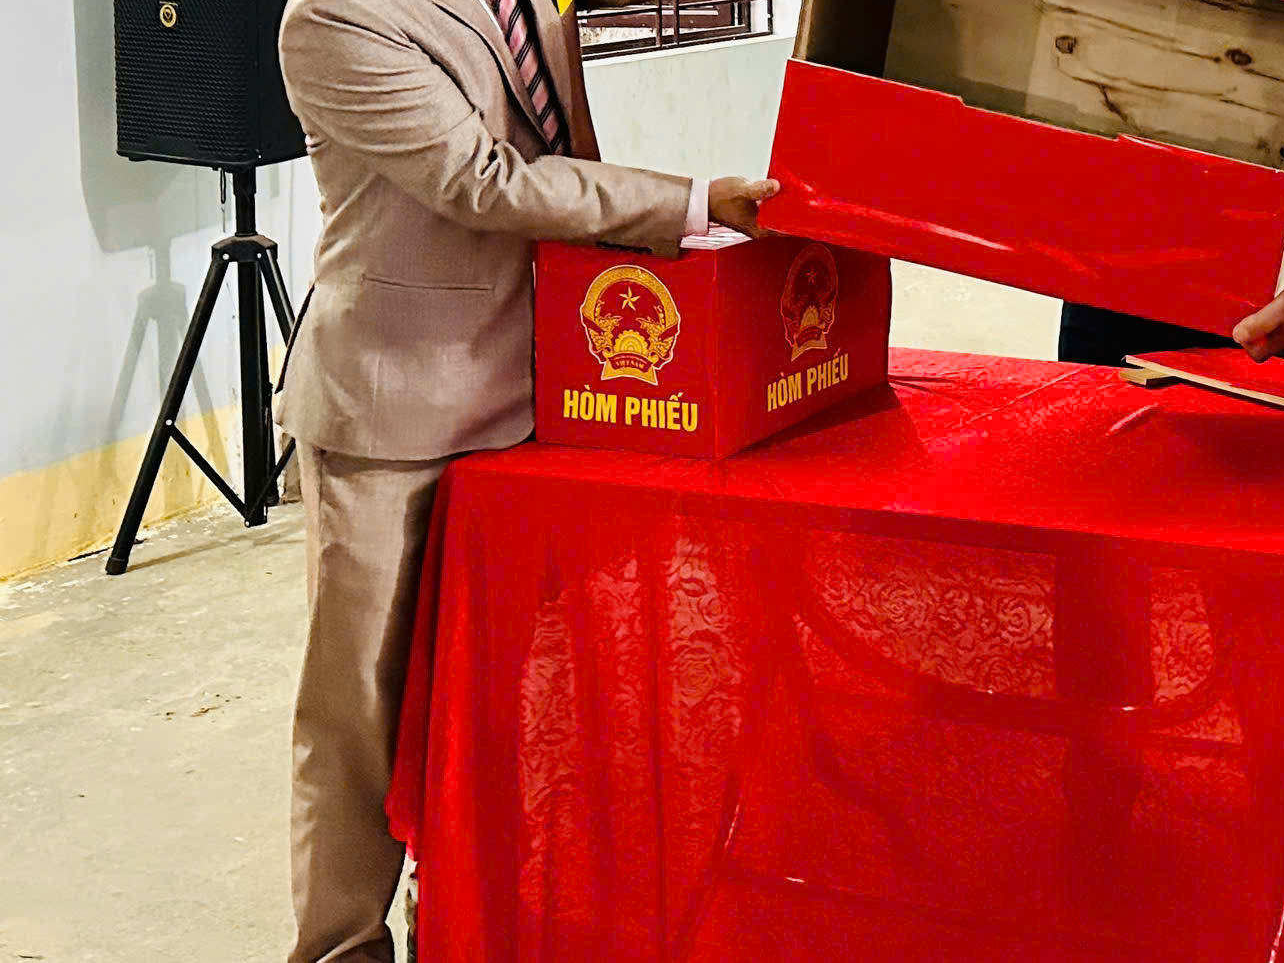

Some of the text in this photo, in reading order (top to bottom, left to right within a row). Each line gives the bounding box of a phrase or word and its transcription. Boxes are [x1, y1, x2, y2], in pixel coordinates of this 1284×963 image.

[563, 384, 698, 432] HÒM PHIẾU
[767, 348, 849, 412] HÒM PHIẾU
